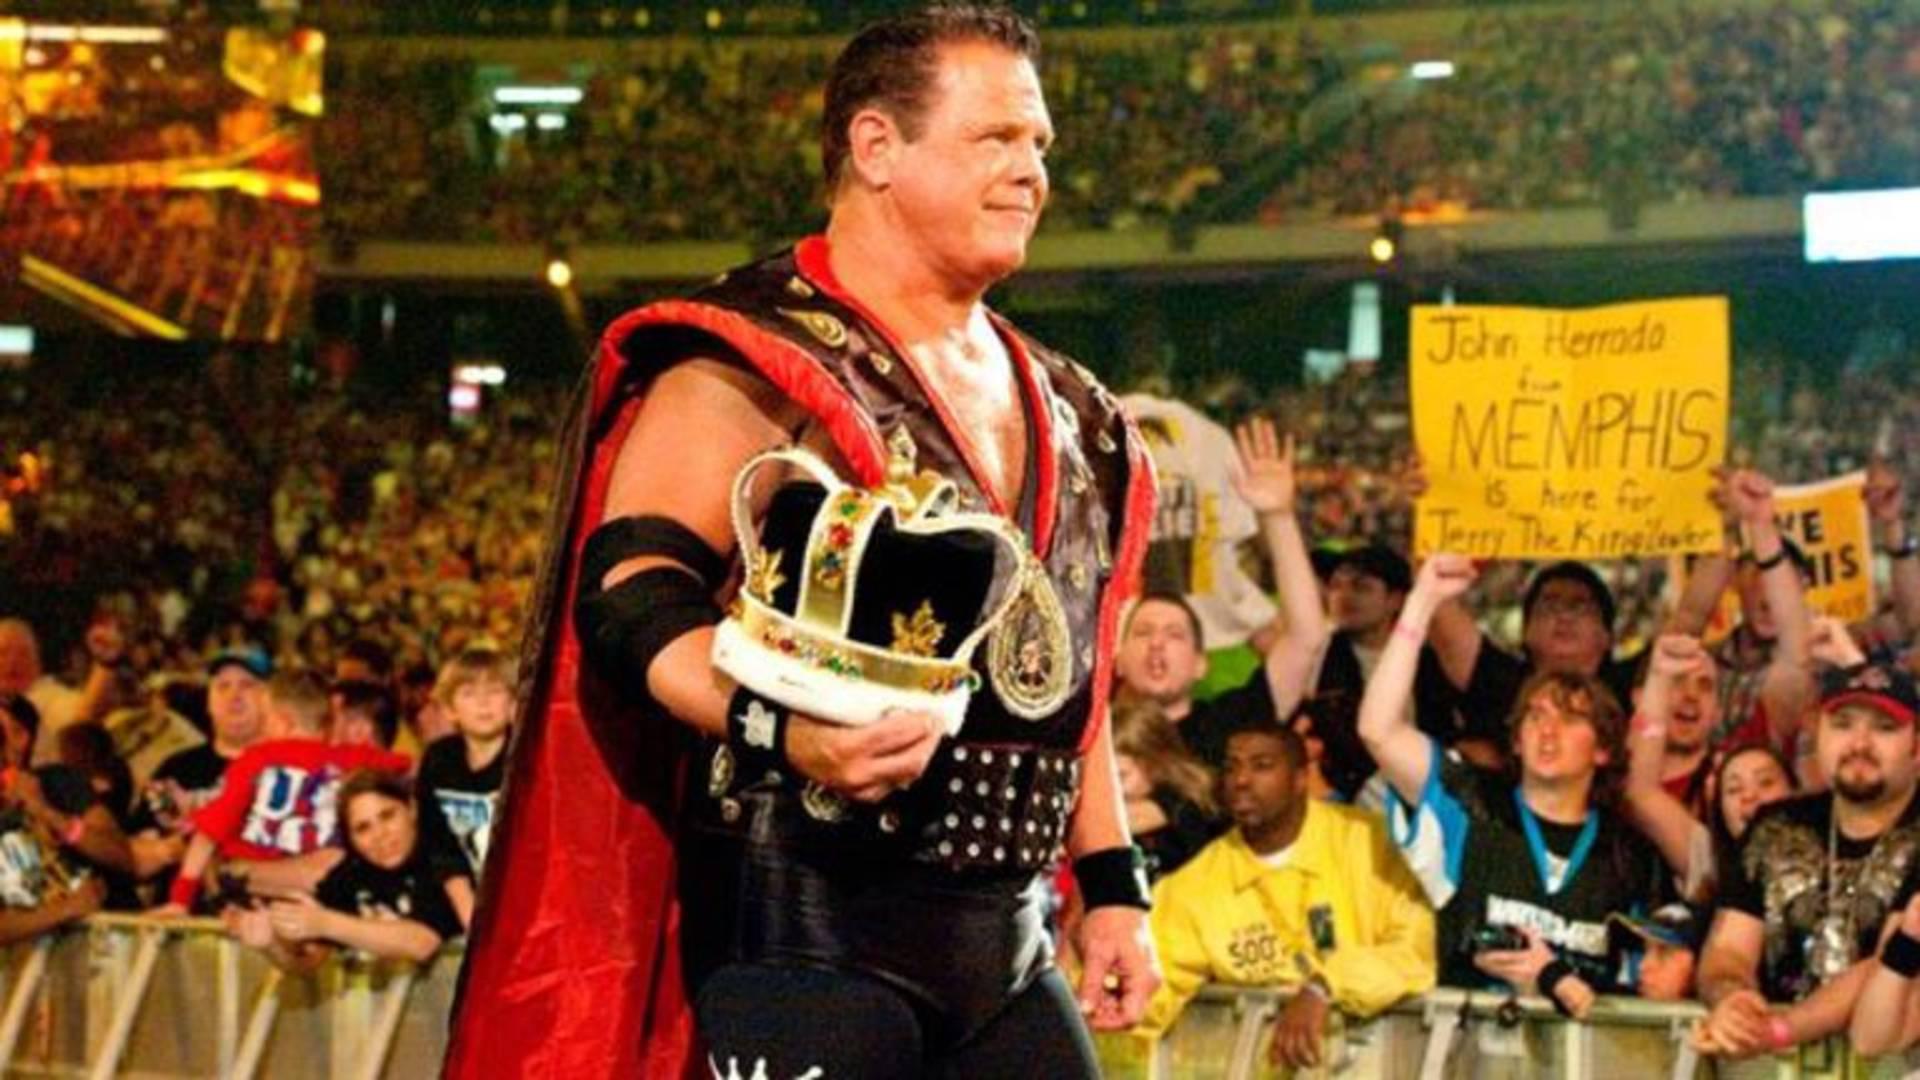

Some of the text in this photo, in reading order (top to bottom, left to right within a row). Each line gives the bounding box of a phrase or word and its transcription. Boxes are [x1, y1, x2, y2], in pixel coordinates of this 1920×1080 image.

[1427, 315, 1517, 364] John
[1450, 388, 1716, 471] MEMPHIS
[1539, 479, 1598, 512] here
